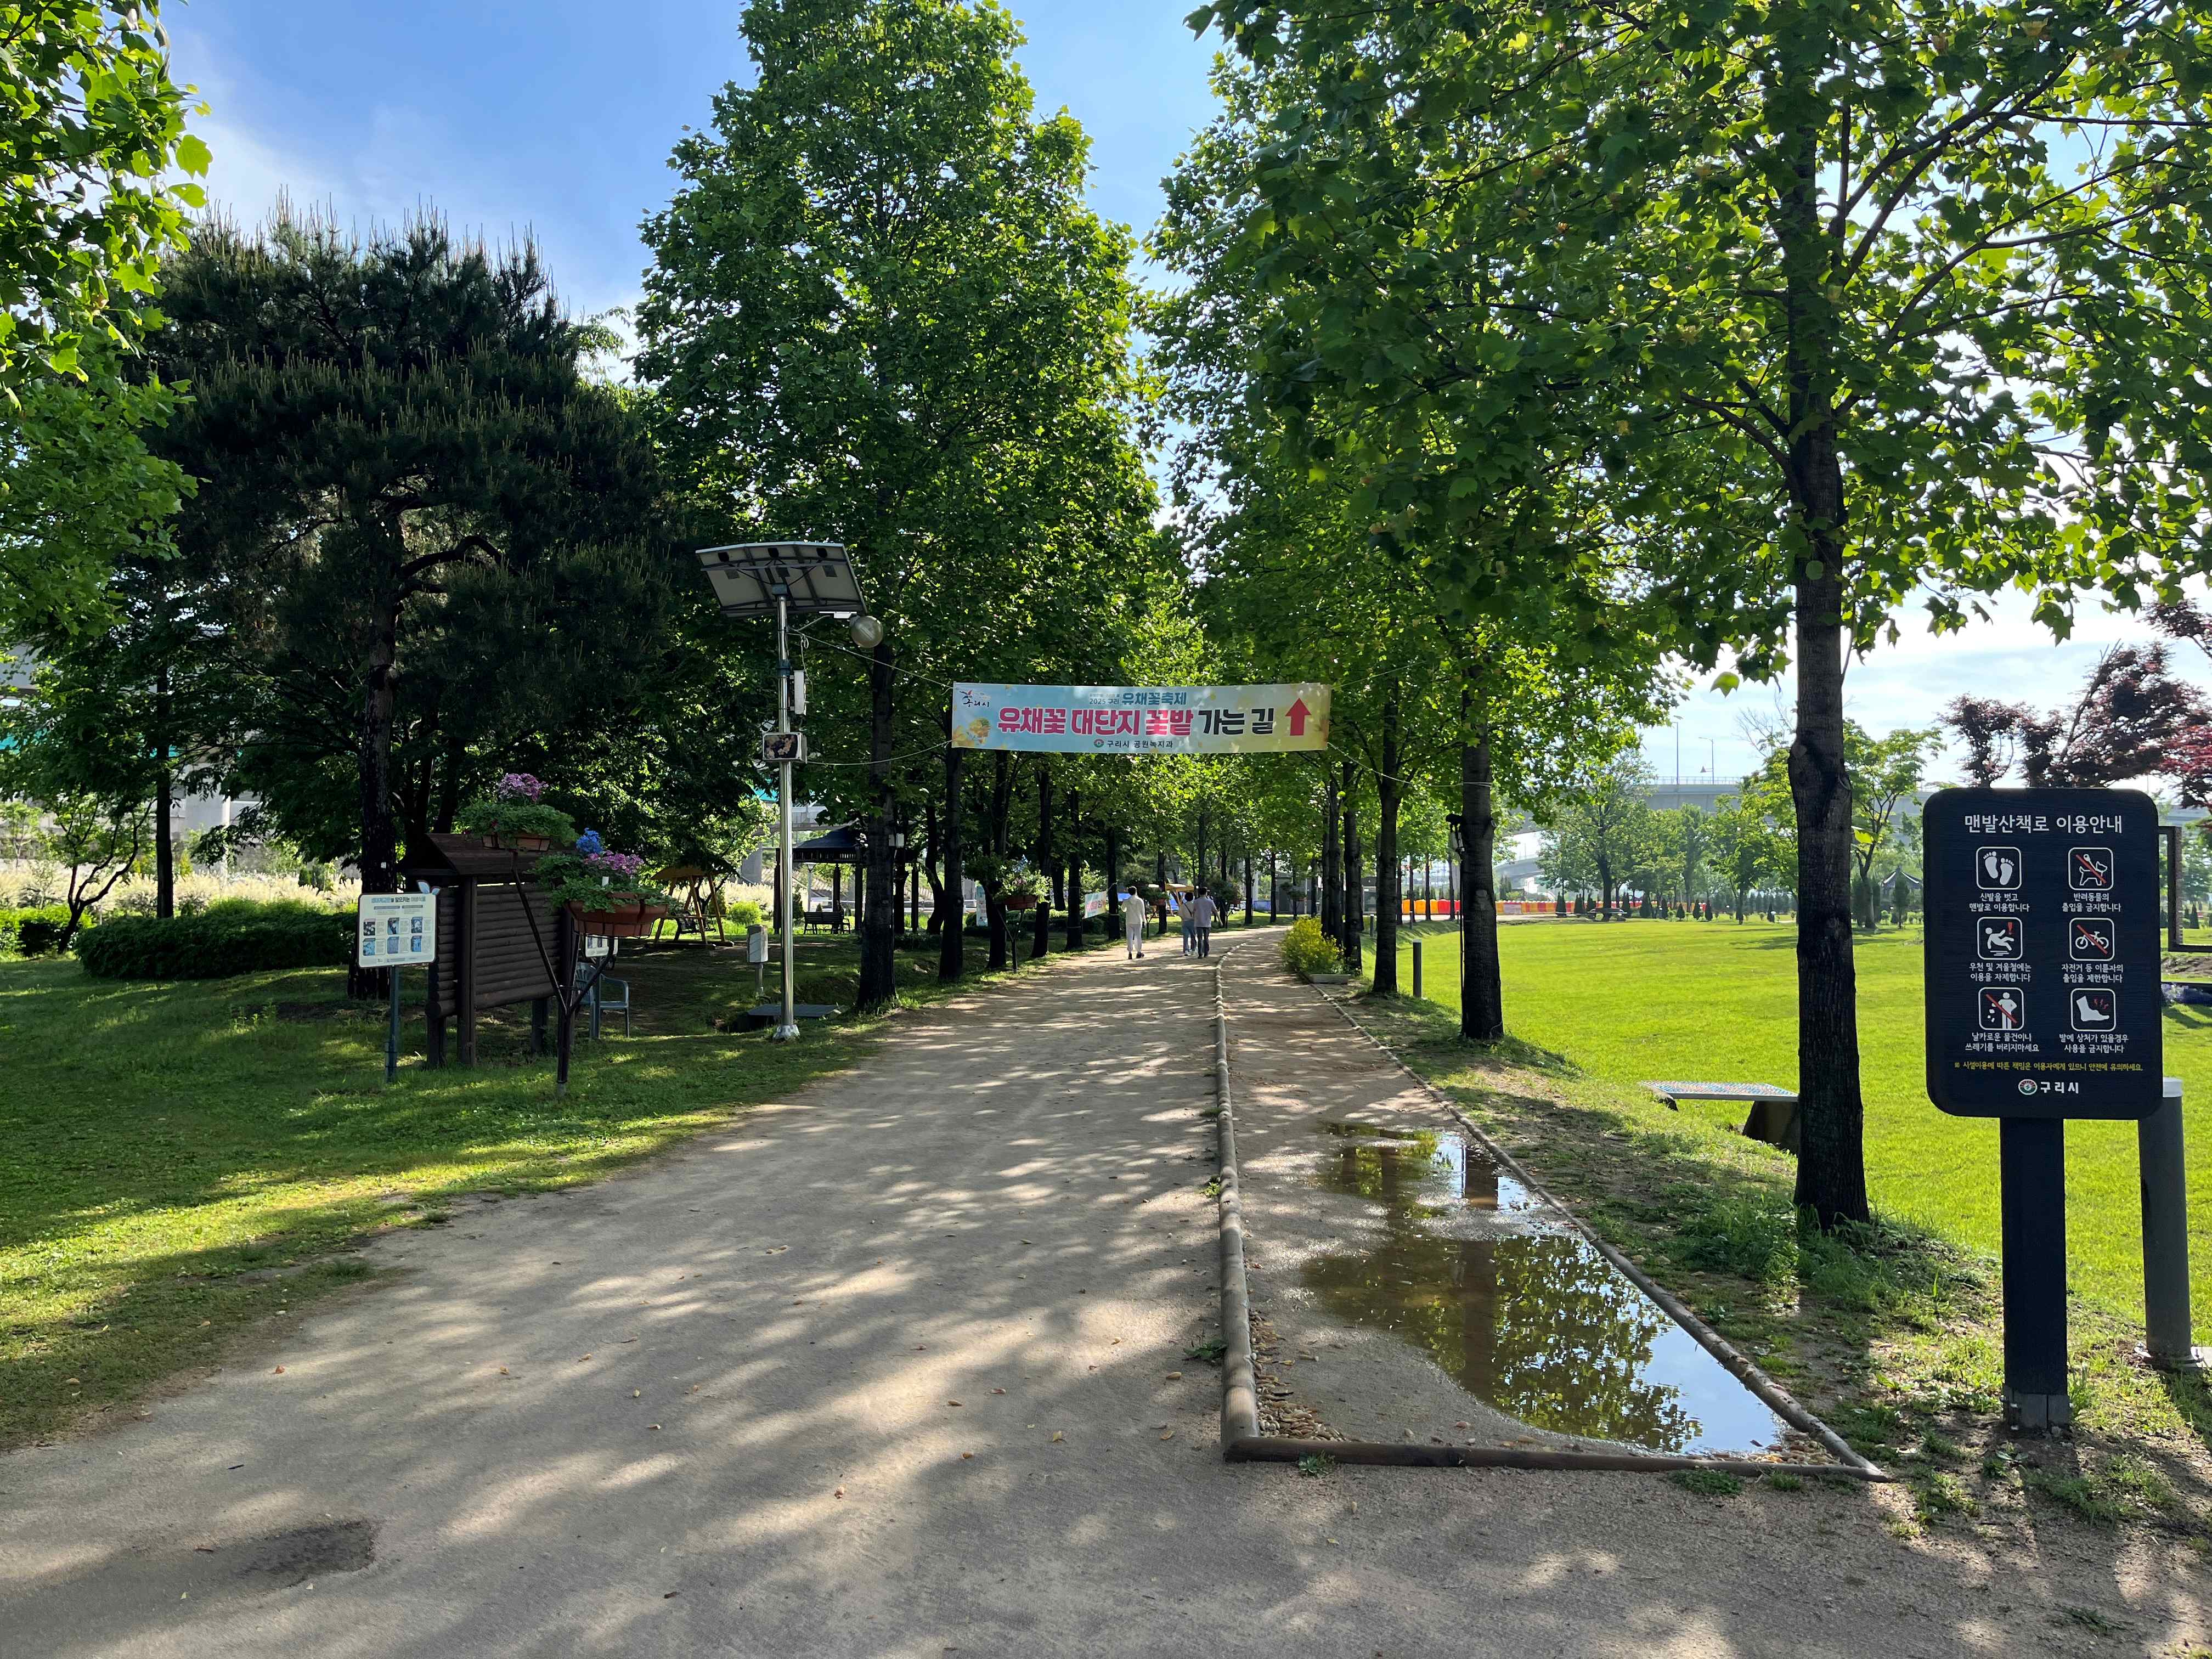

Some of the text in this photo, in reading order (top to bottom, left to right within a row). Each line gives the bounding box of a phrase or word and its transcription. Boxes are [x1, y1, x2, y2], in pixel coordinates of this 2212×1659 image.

[1122, 692, 1187, 706] 유채꽃축제
[998, 707, 1275, 736] 유채꽃 대단지 꽃밭 가는 길
[1134, 740, 1173, 748] 공원녹지과
[1965, 814, 2122, 834] 맨발산책로 이용안내
[1979, 893, 2019, 901] 신발을 벗고
[2073, 893, 2109, 902] 반려동물의
[1969, 902, 2030, 912] 맨발로 이용합니다
[2062, 902, 2121, 912] 출입을 금지합니다
[1969, 962, 2032, 972] 우천 및 겨울철에는
[2062, 963, 2083, 972] 자전거
[2085, 963, 2092, 973] 등
[1970, 973, 2031, 982] 이용을 자제합니다
[2063, 973, 2123, 983] 출입을 제한합니다
[1972, 1032, 2001, 1041] 날카로운
[2059, 1033, 2129, 1043] 발에 상처가 있을경우
[1965, 1043, 2040, 1052] 쓰레기를 버리지마세요
[2064, 1044, 2124, 1053] 사용을 금지합니다
[2033, 1062, 2066, 1070] 이용자에게
[2068, 1062, 2086, 1071] 있으니
[2041, 1081, 2079, 1094] 구리시
